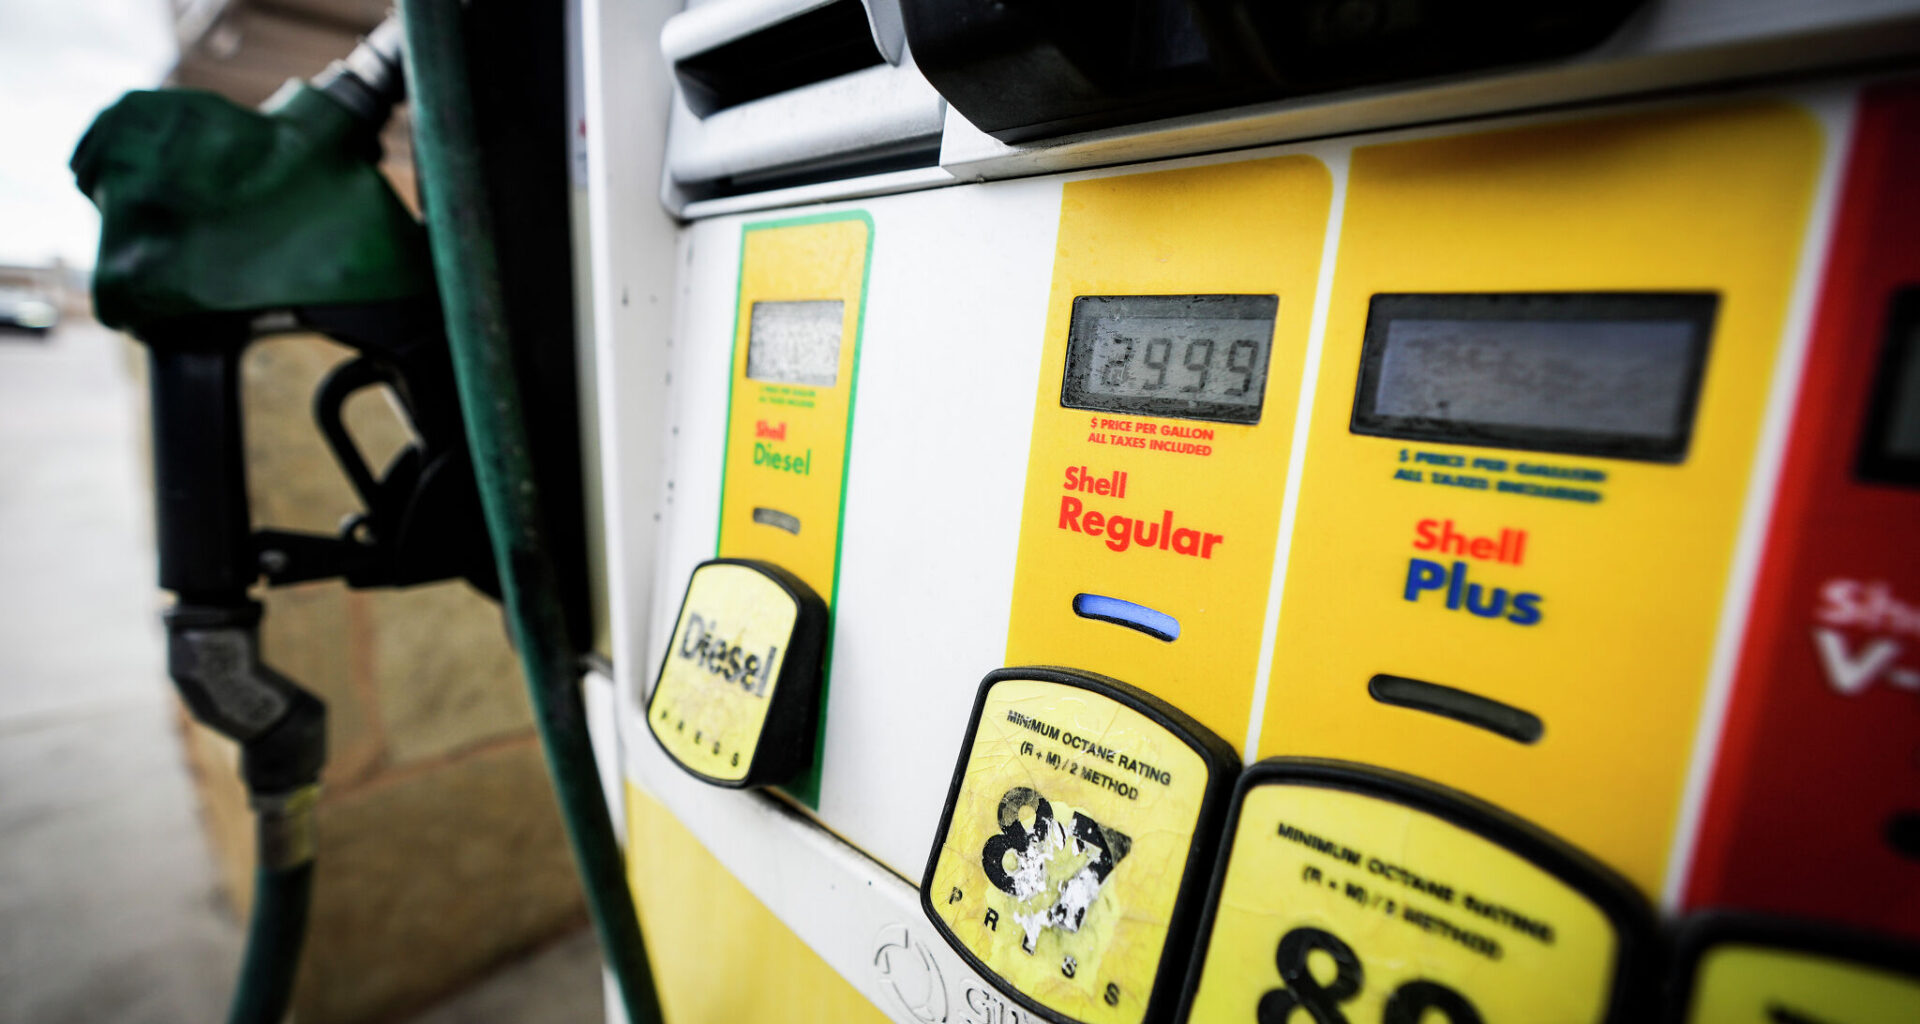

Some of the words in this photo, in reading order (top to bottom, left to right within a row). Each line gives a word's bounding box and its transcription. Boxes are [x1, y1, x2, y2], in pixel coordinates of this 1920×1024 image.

[1088, 433, 1107, 444] ALL
[1110, 435, 1146, 448] TAXES
[1150, 440, 1212, 456] INCLUDED
[1091, 417, 1098, 429] $
[1101, 419, 1132, 432] PRICE
[1135, 422, 1157, 435] PER
[1161, 425, 1214, 440] GALLON
[753, 442, 812, 476] Diesel
[1063, 465, 1128, 499] Shell
[1058, 495, 1224, 560] Regular
[1413, 518, 1528, 566] Shell
[1403, 557, 1544, 627] Plus
[677, 612, 777, 699] Diesel
[1007, 710, 1060, 741] MINIMUM
[1062, 732, 1116, 763] OCTANE
[1118, 755, 1172, 786] RATING
[1082, 766, 1138, 800] METHOD
[1277, 822, 1362, 866] MINIMUM
